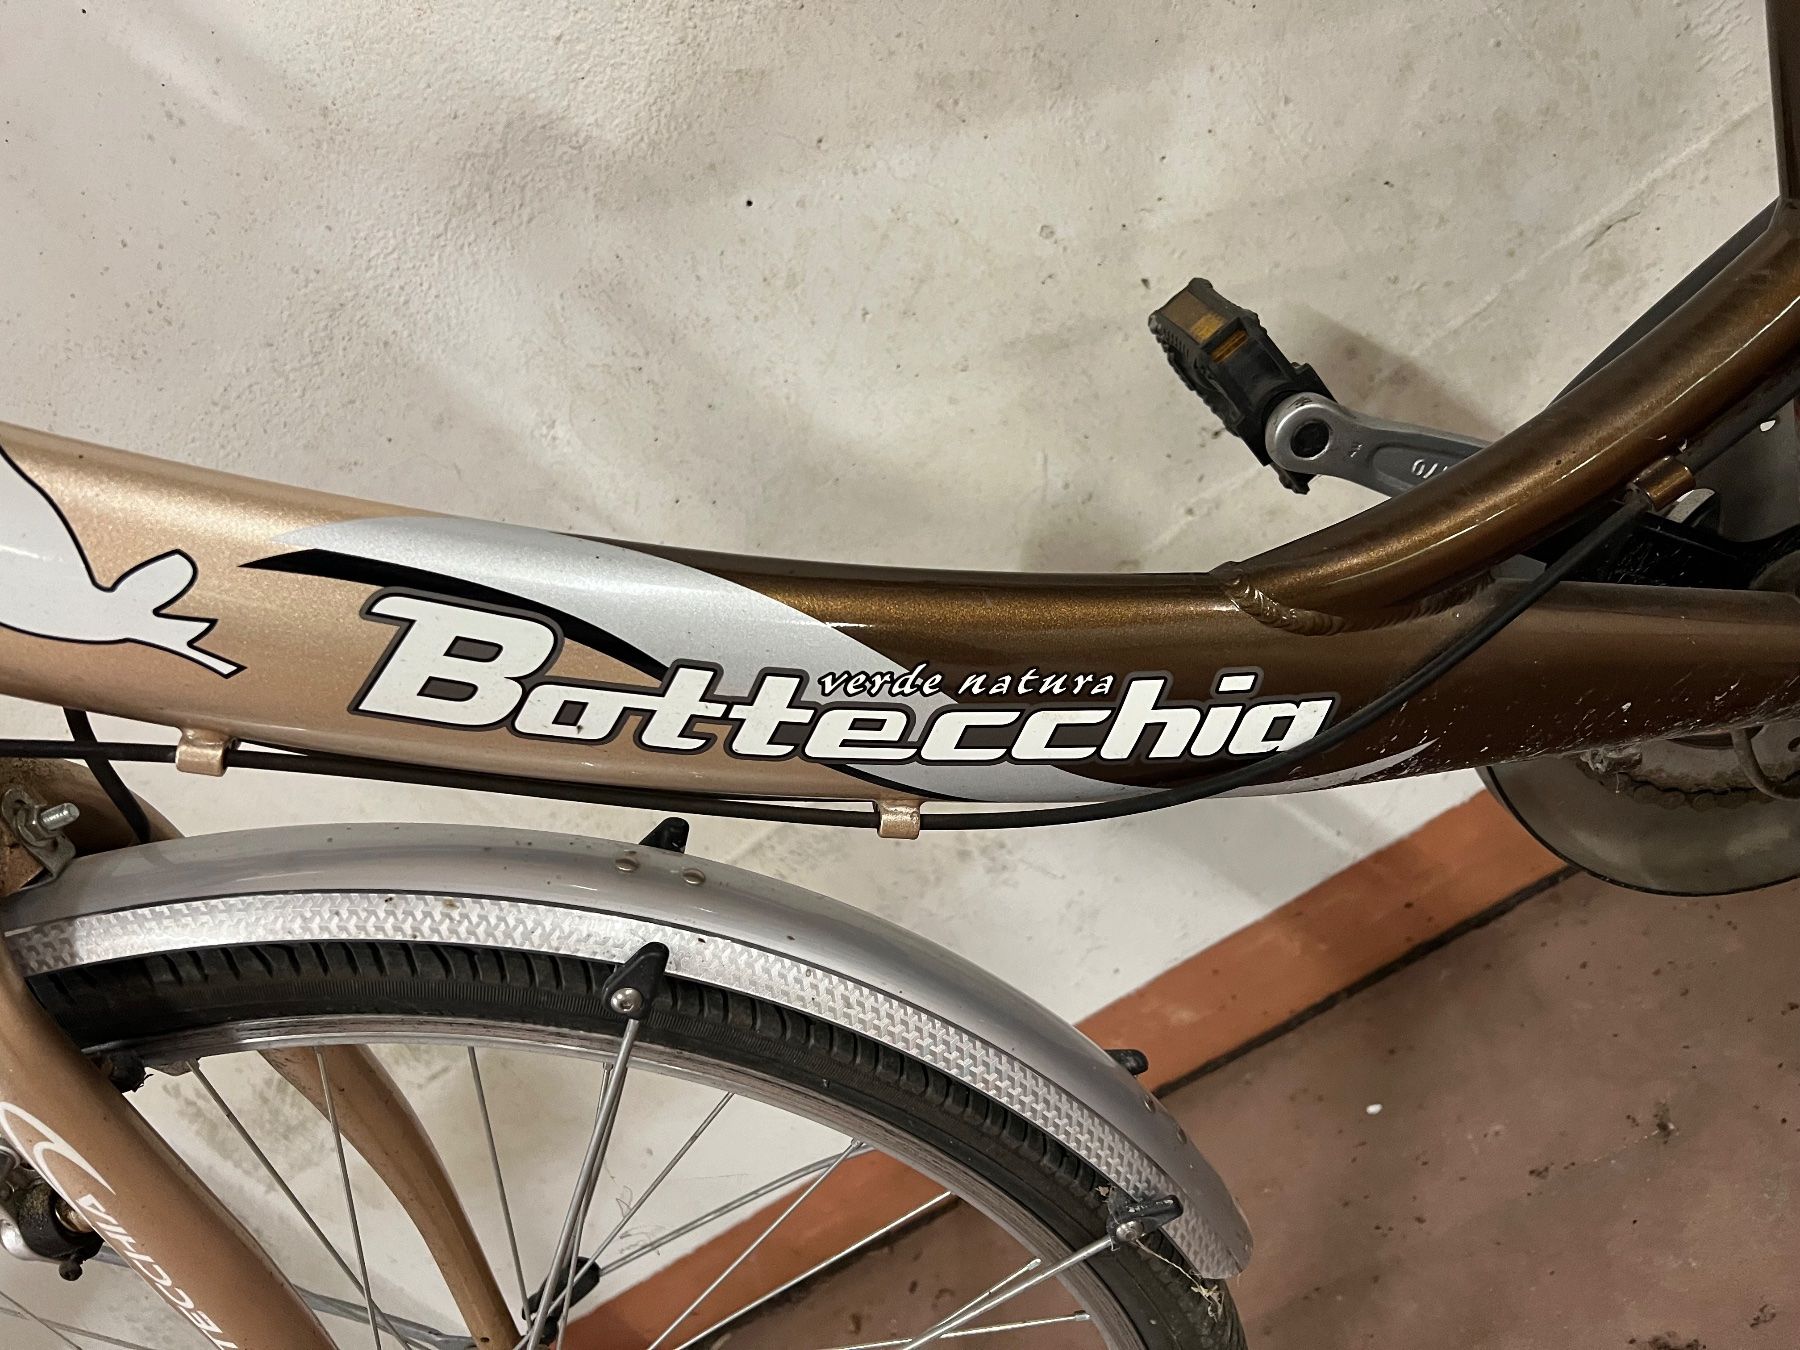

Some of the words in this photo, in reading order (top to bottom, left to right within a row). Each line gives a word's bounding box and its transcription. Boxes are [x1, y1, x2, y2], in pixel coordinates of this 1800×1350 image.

[352, 590, 1338, 763] Bottecchia
[819, 662, 943, 697] verde
[957, 667, 1116, 696] natura
